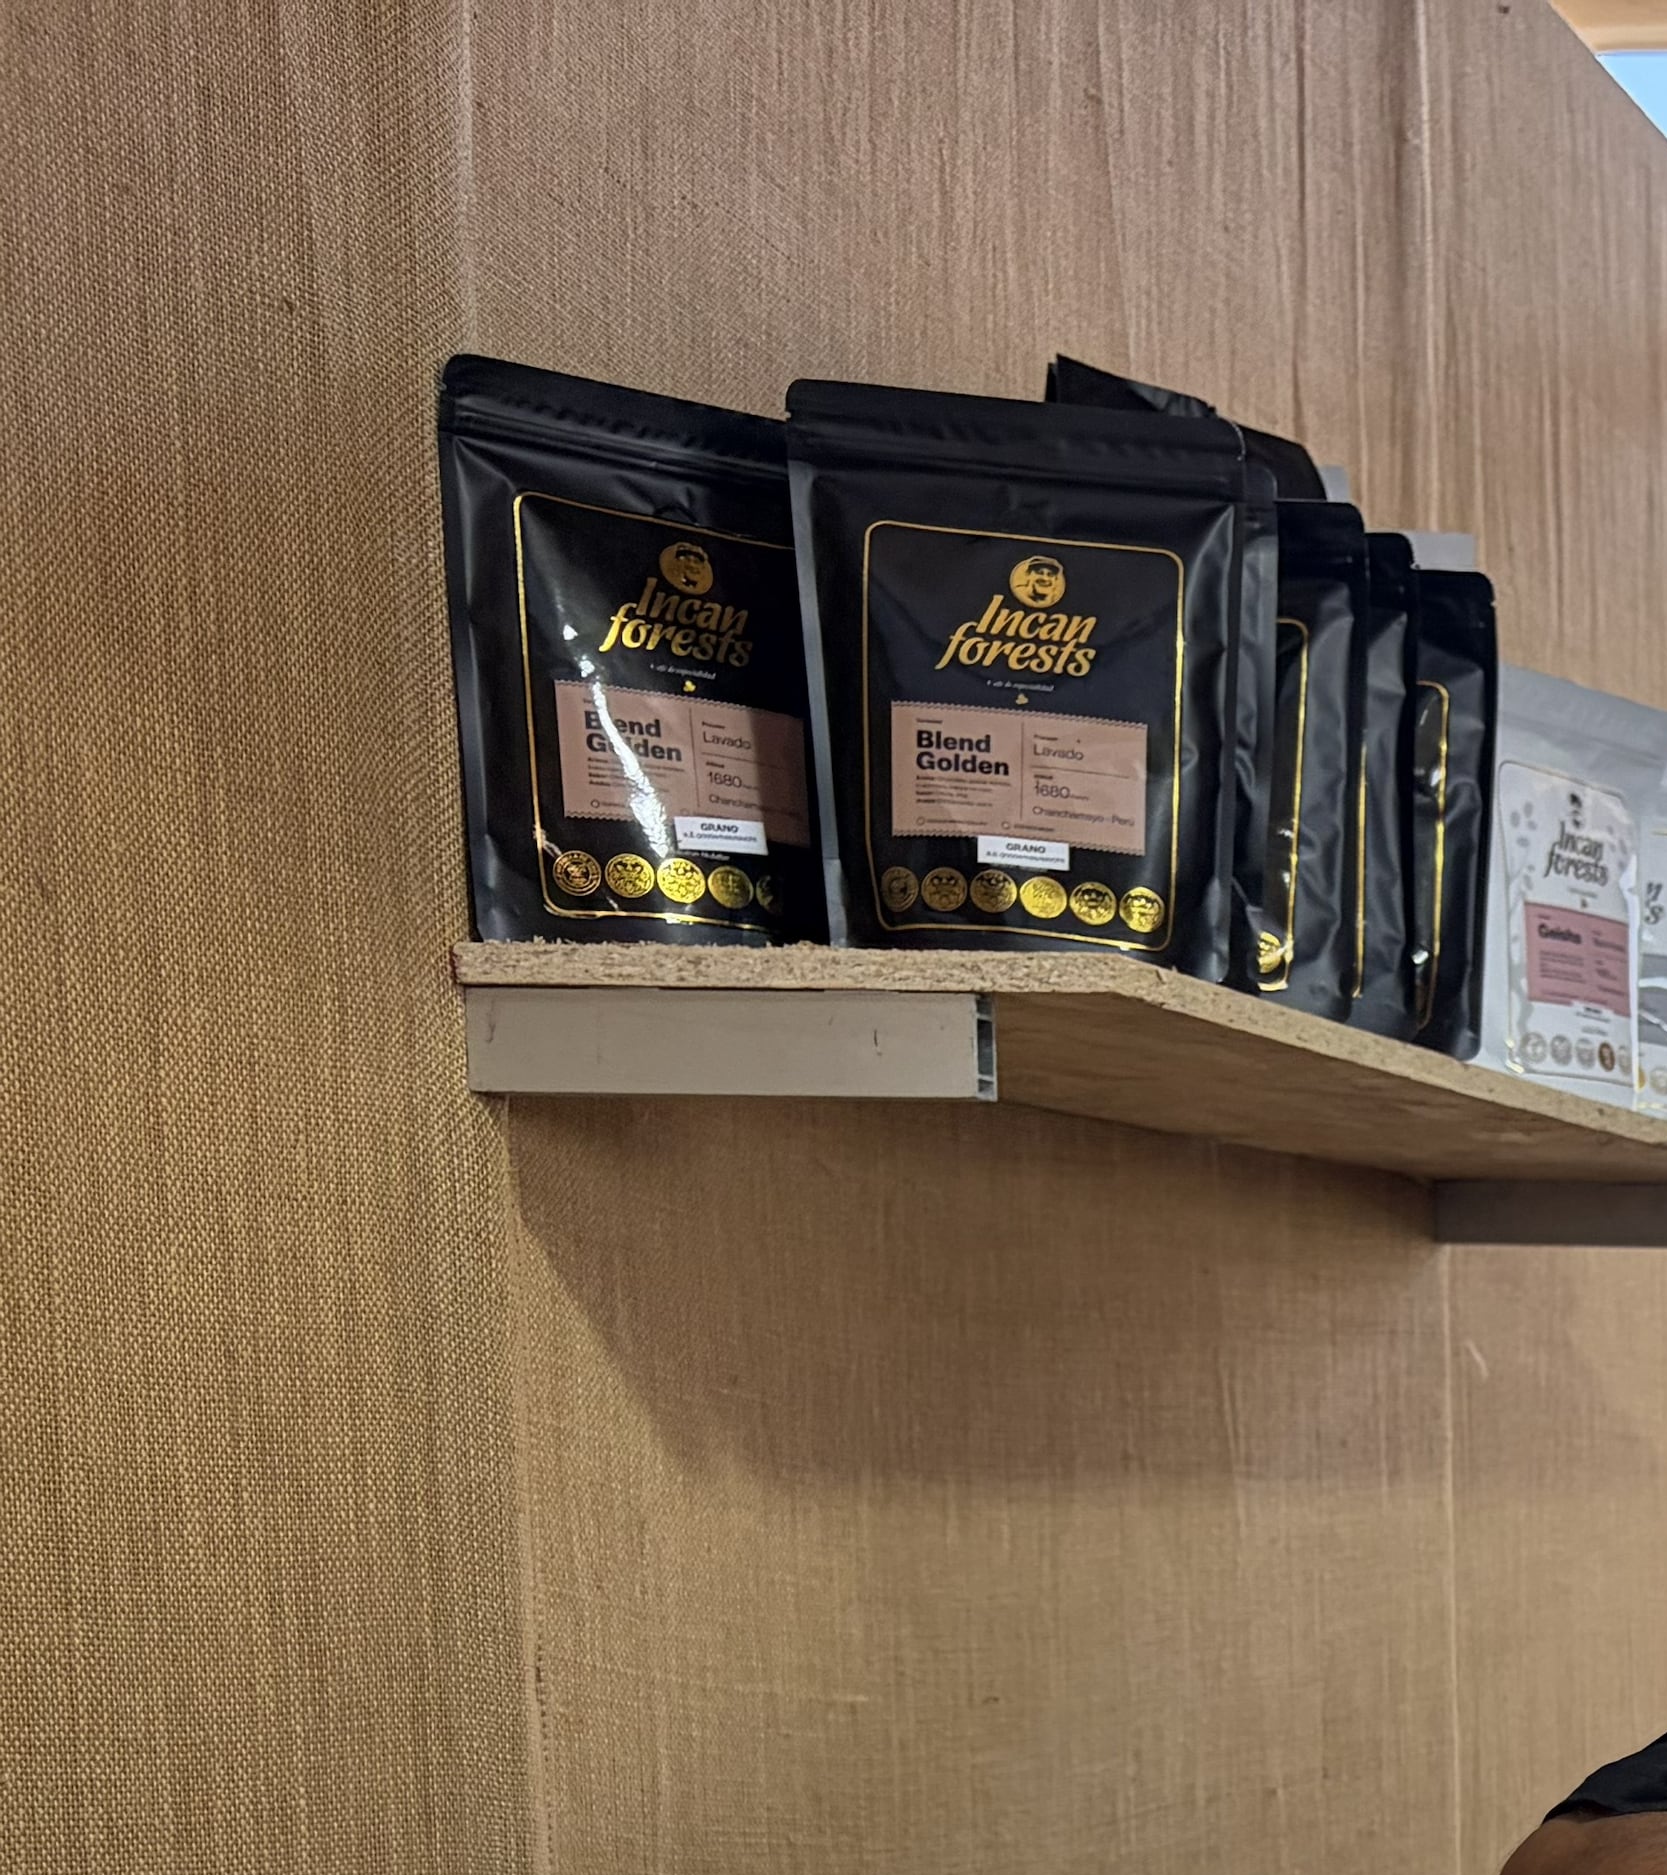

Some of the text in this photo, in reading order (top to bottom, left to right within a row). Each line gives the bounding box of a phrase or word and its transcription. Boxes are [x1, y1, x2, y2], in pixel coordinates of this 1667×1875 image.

[635, 577, 749, 635] Incan
[975, 594, 1098, 644] Incan
[599, 602, 753, 668] forests
[935, 621, 1097, 677] forests
[584, 710, 661, 738] Bend
[703, 731, 752, 750] Lavado
[916, 730, 991, 753] Blend
[1033, 744, 1084, 761] Lavado
[916, 752, 1010, 776] Golden
[1006, 842, 1047, 854] GRANO
